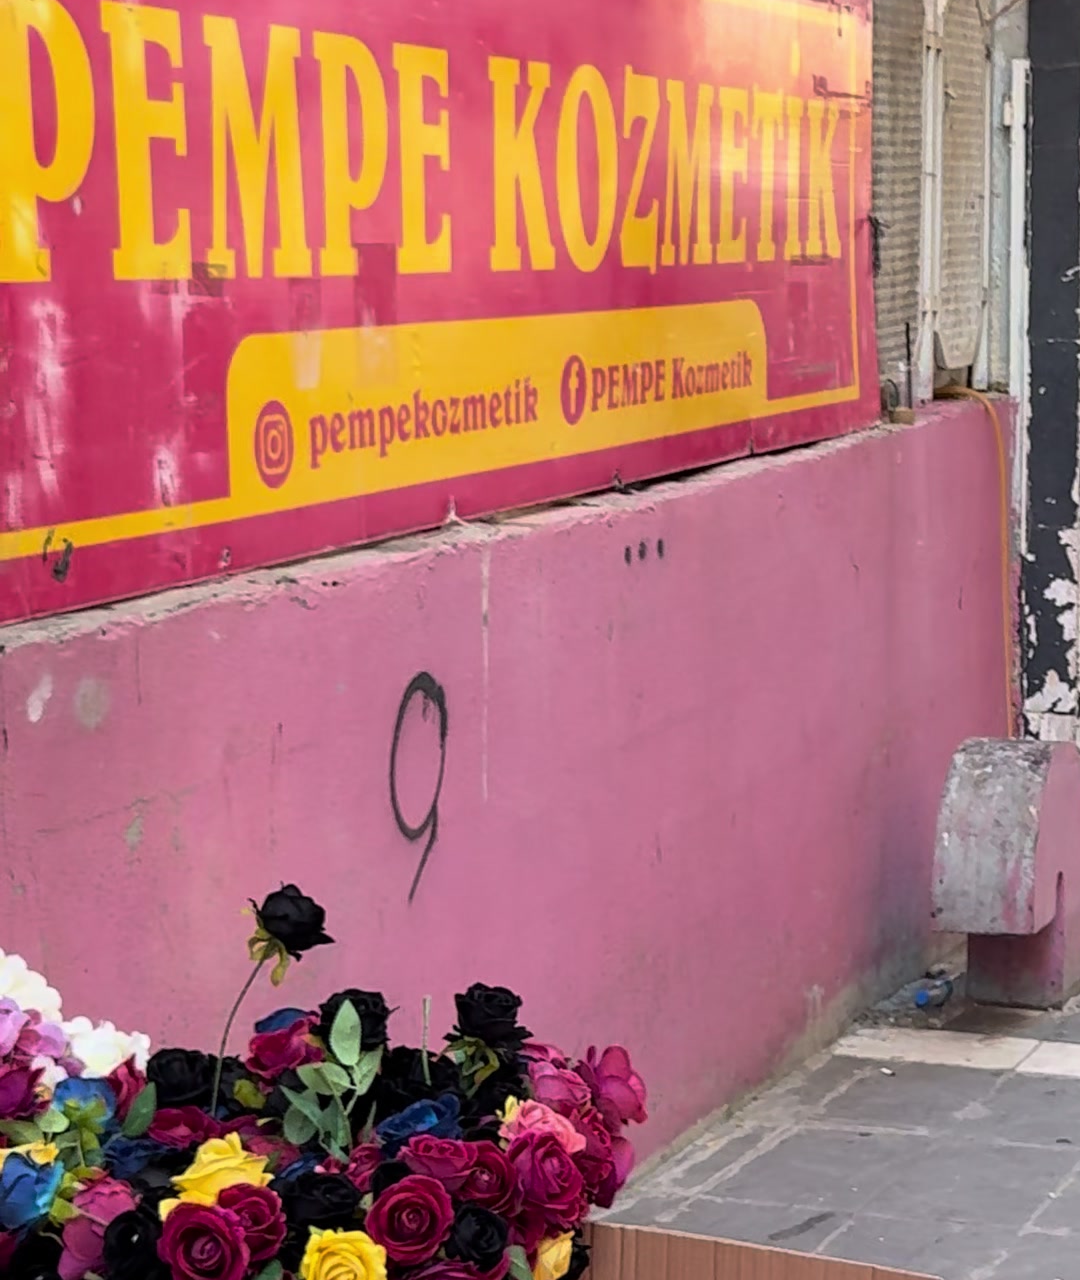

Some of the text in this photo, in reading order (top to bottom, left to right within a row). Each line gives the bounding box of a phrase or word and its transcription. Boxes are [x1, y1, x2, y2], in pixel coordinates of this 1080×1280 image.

[309, 377, 539, 469] pempekozmetik
[591, 359, 666, 412] PEMPE
[672, 351, 753, 398] Kozmetik
